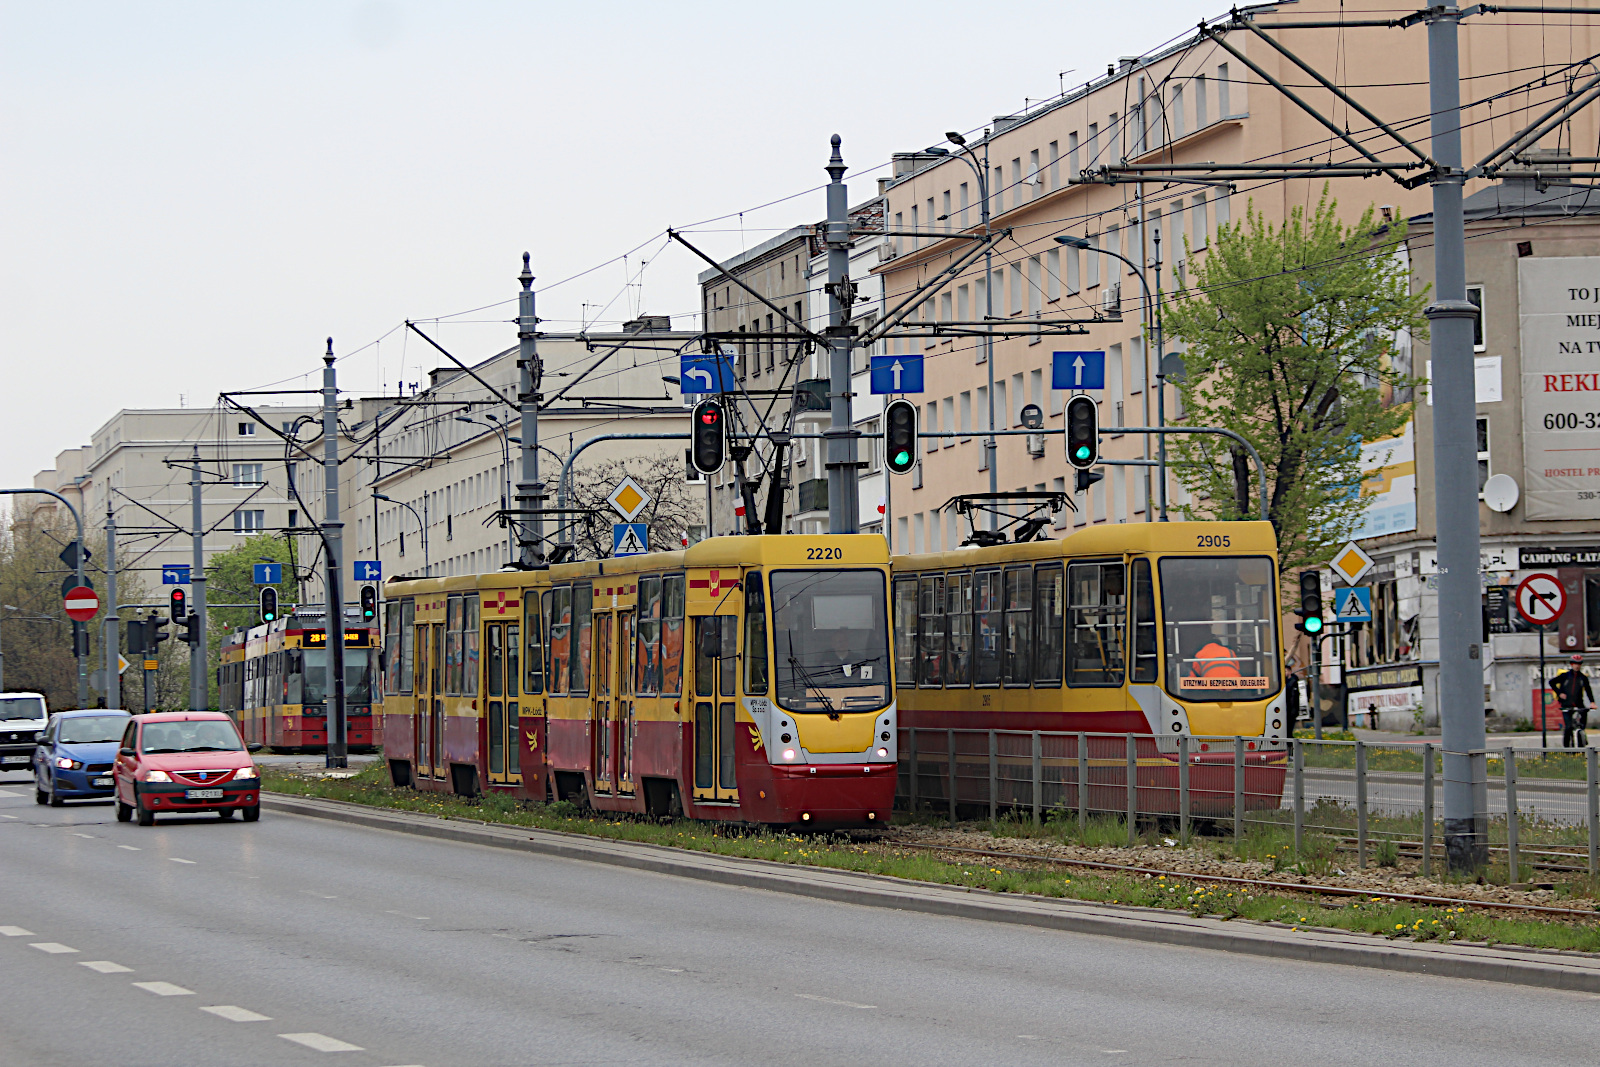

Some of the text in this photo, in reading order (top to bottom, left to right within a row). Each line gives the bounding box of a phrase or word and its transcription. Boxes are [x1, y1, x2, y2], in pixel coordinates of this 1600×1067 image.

[1568, 288, 1589, 301] TO
[1559, 342, 1582, 354] NA
[1543, 374, 1600, 392] REKL
[1543, 413, 1600, 430] 600-3
[1545, 469, 1585, 477] HOSTEL
[1196, 535, 1231, 547] 2905
[806, 547, 842, 560] 2220
[1521, 553, 1571, 563] CAMPING
[1183, 679, 1207, 687] UTRZYMUJ
